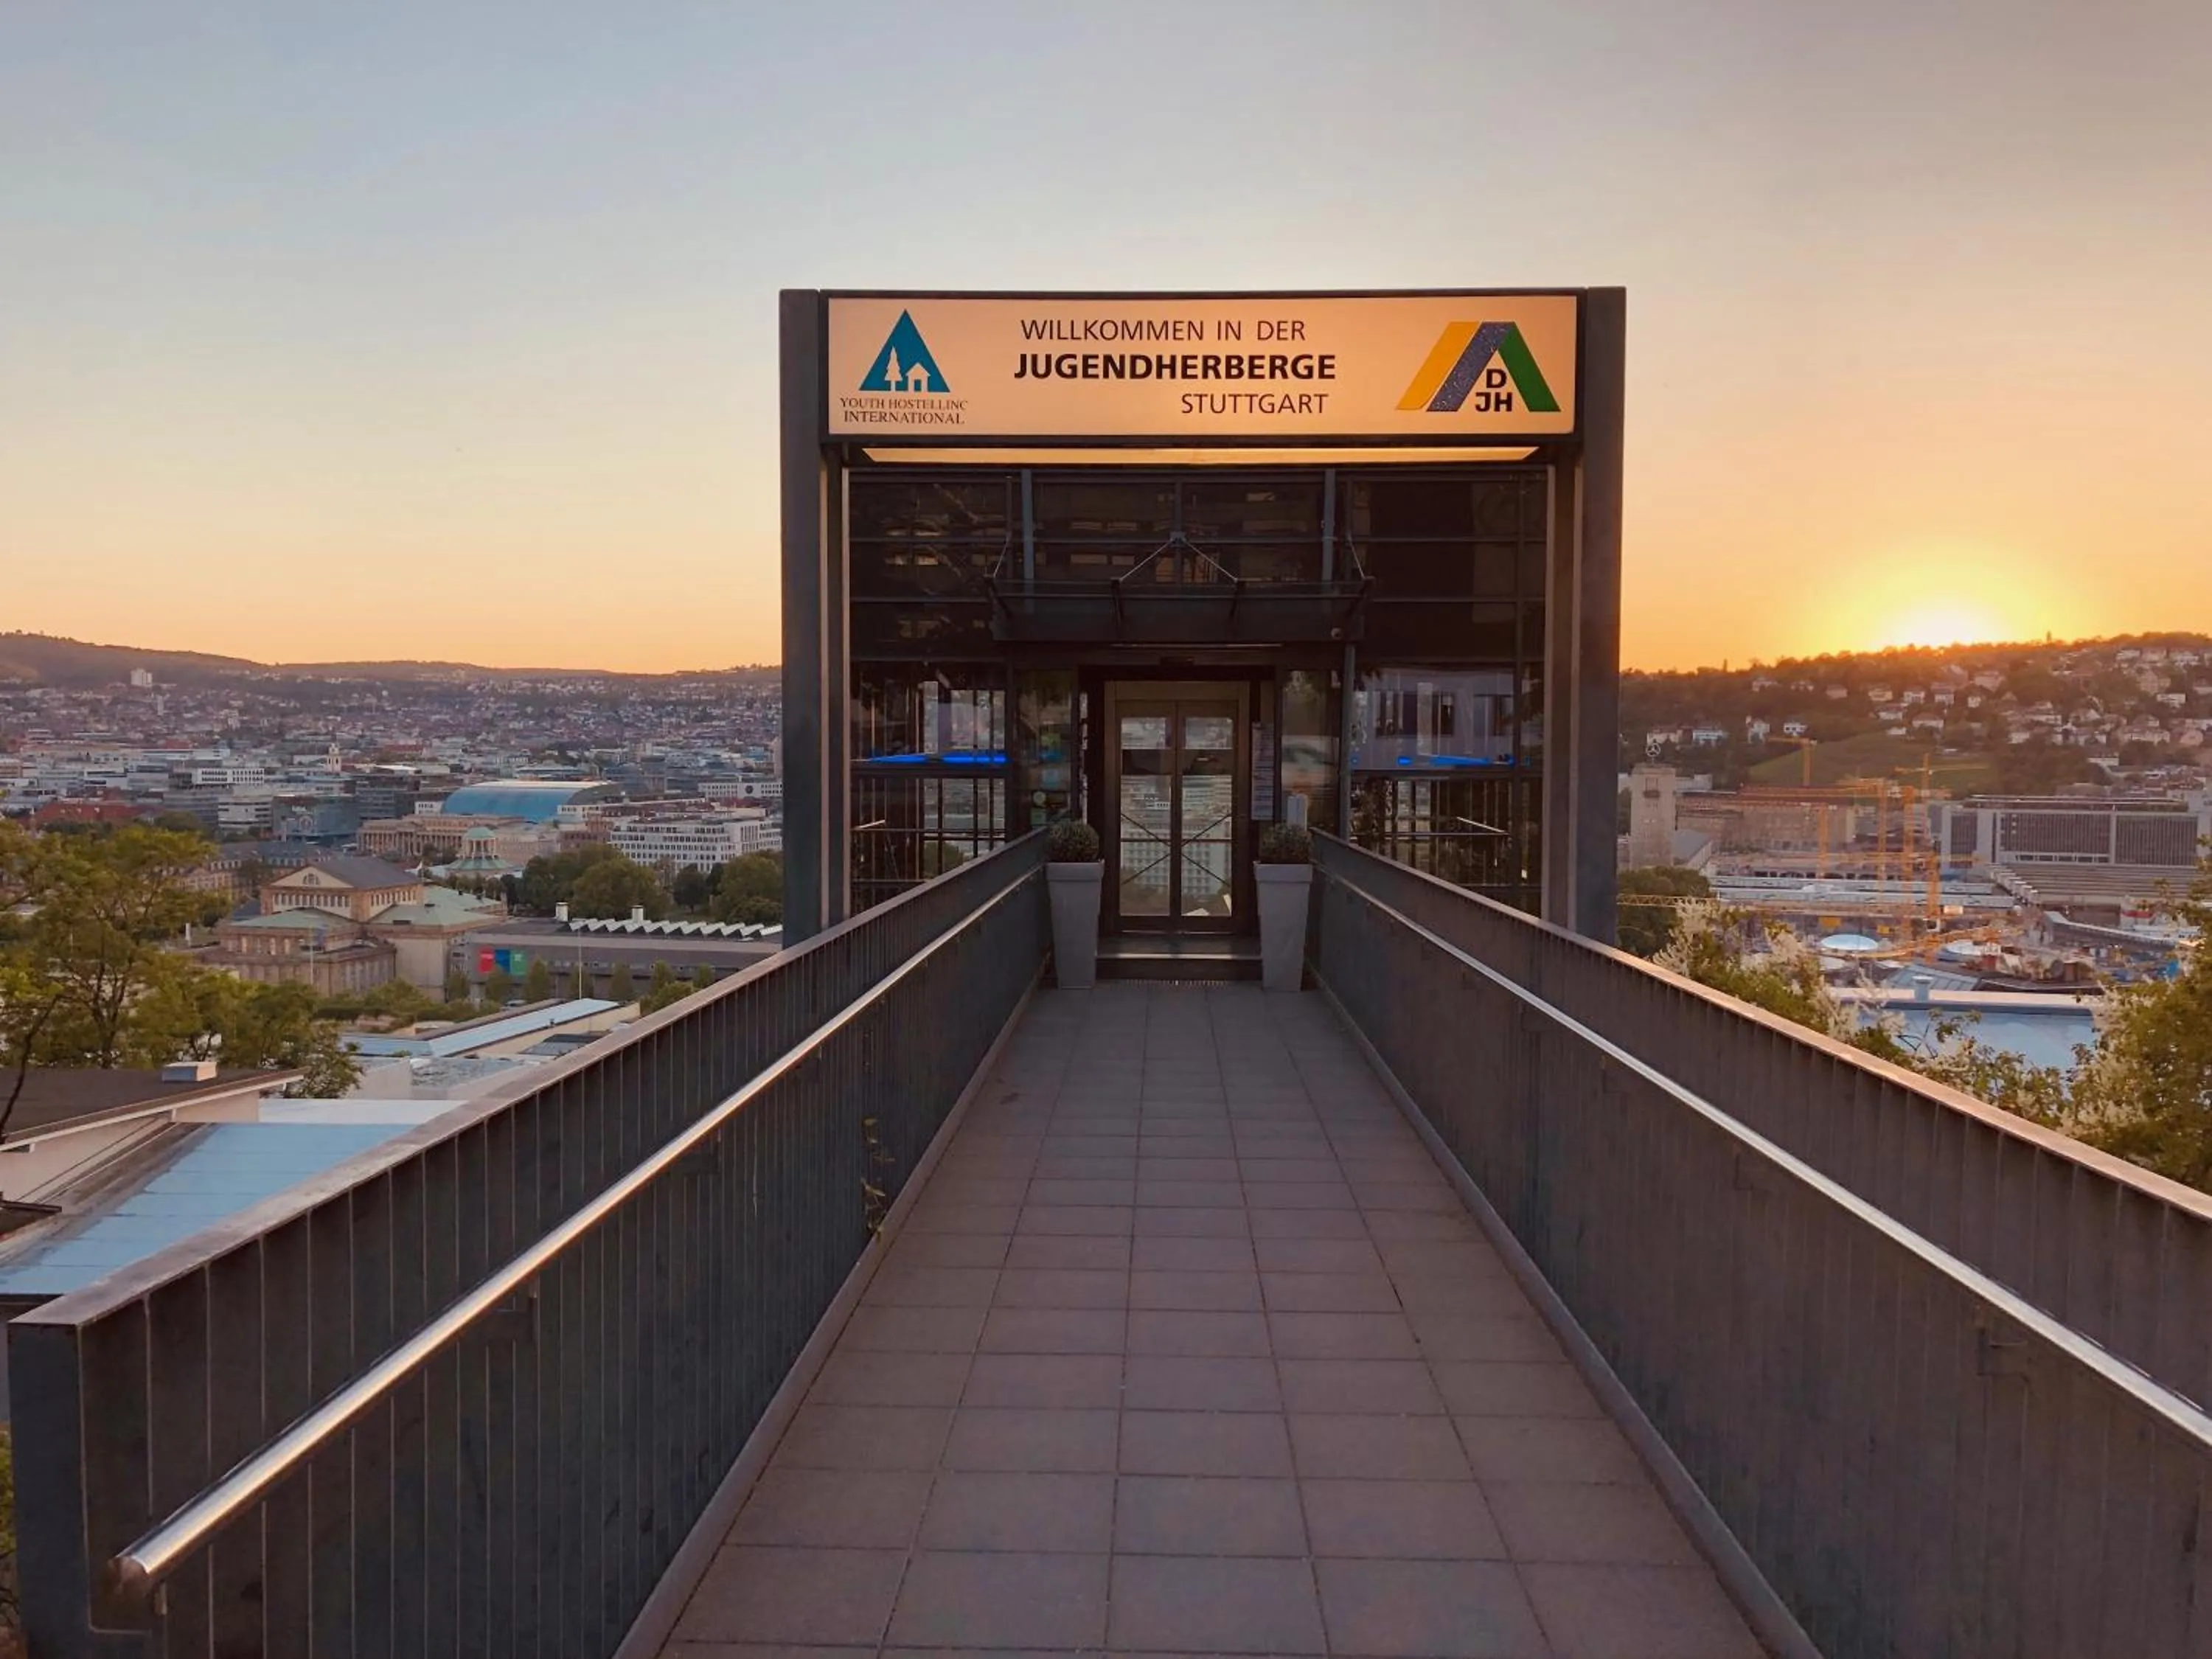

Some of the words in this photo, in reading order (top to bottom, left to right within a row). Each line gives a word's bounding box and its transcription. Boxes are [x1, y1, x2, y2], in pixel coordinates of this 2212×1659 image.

[1021, 319, 1204, 341] WILLKOMMEN
[1217, 320, 1241, 341] IN
[1256, 320, 1306, 341] DER
[1014, 353, 1336, 380] JUGENDHERBERGE
[1486, 368, 1508, 389] D
[840, 397, 885, 409] YOUTH
[1181, 393, 1329, 414] STUTTGART
[1475, 392, 1513, 413] JH
[844, 410, 965, 425] INTERNATIONAL
